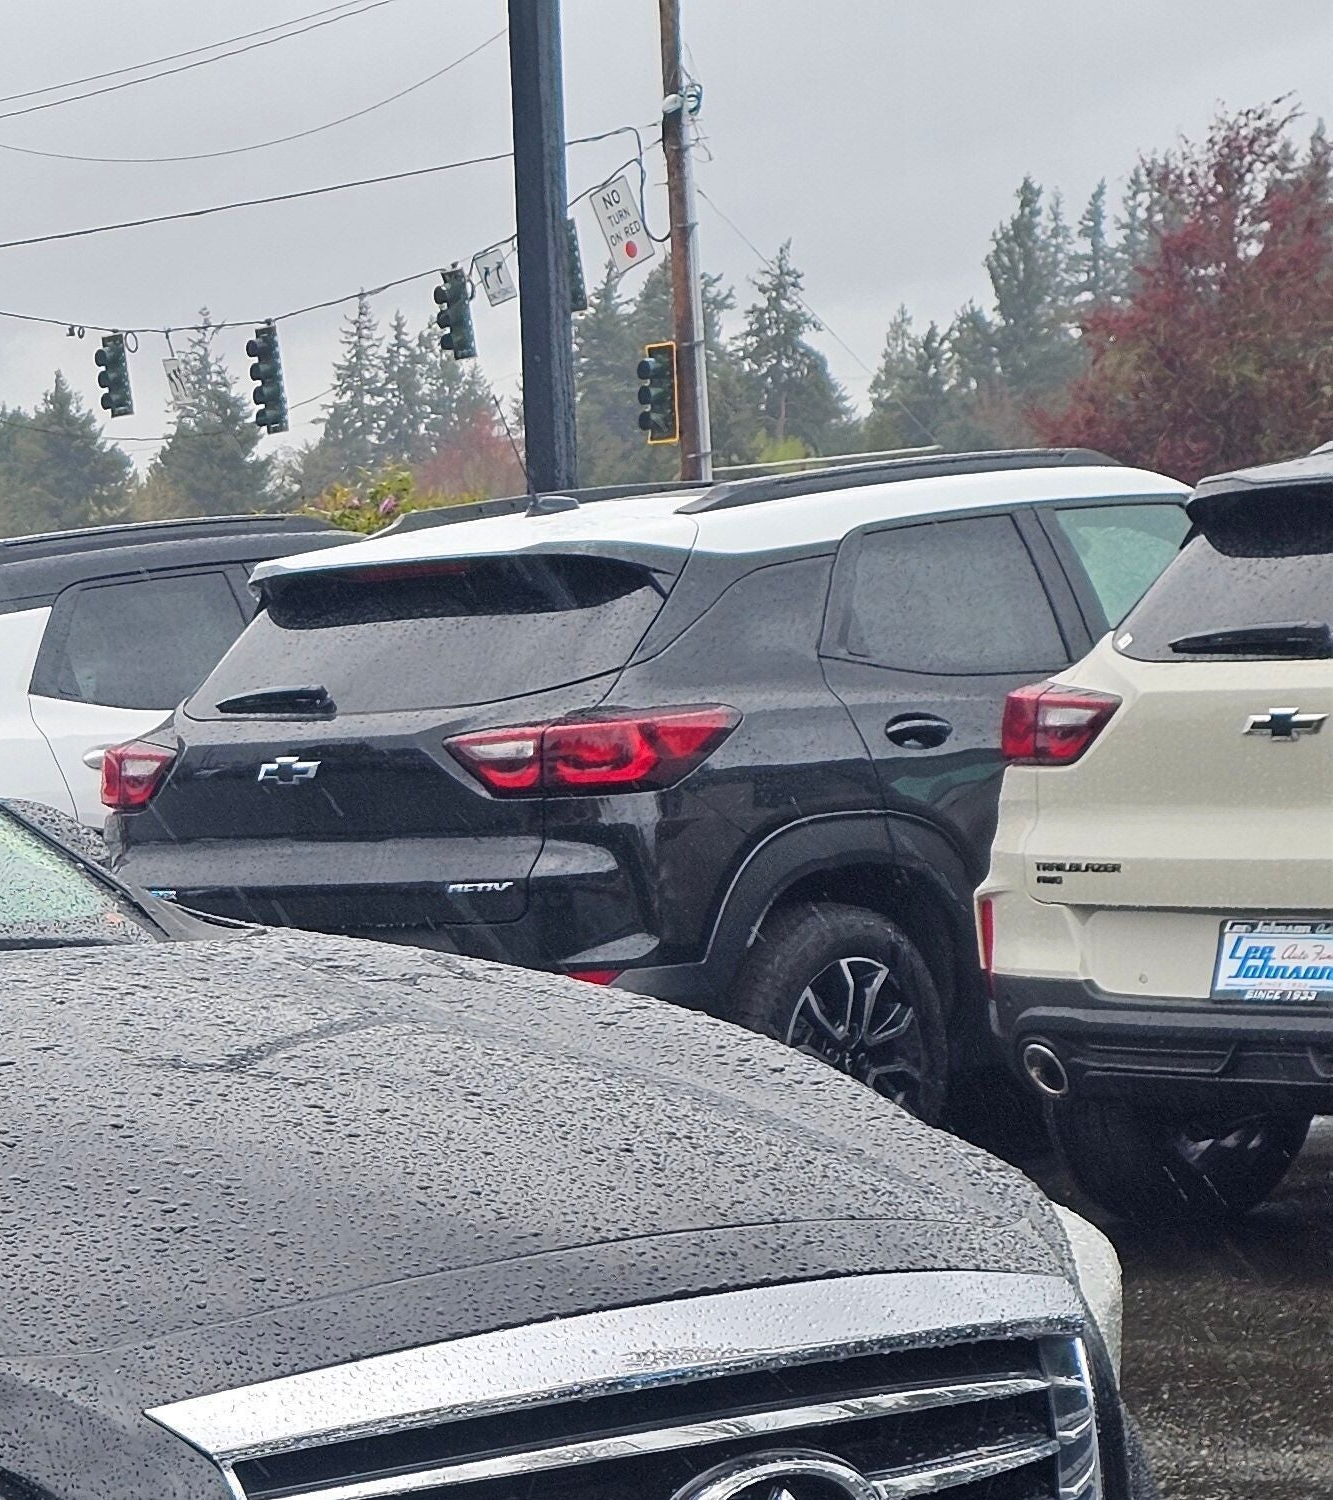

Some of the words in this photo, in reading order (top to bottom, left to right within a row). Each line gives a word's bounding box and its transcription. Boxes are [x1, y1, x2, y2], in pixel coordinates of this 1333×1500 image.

[602, 189, 621, 210] NO
[607, 207, 631, 227] TURN
[609, 231, 623, 246] ON
[623, 220, 641, 238] RED
[1035, 862, 1121, 873] TRAILBLAZER
[447, 882, 513, 893] ACTIV
[1229, 936, 1276, 960] Lee
[1245, 990, 1283, 1000] SINCE
[1286, 990, 1318, 1000] 1933
